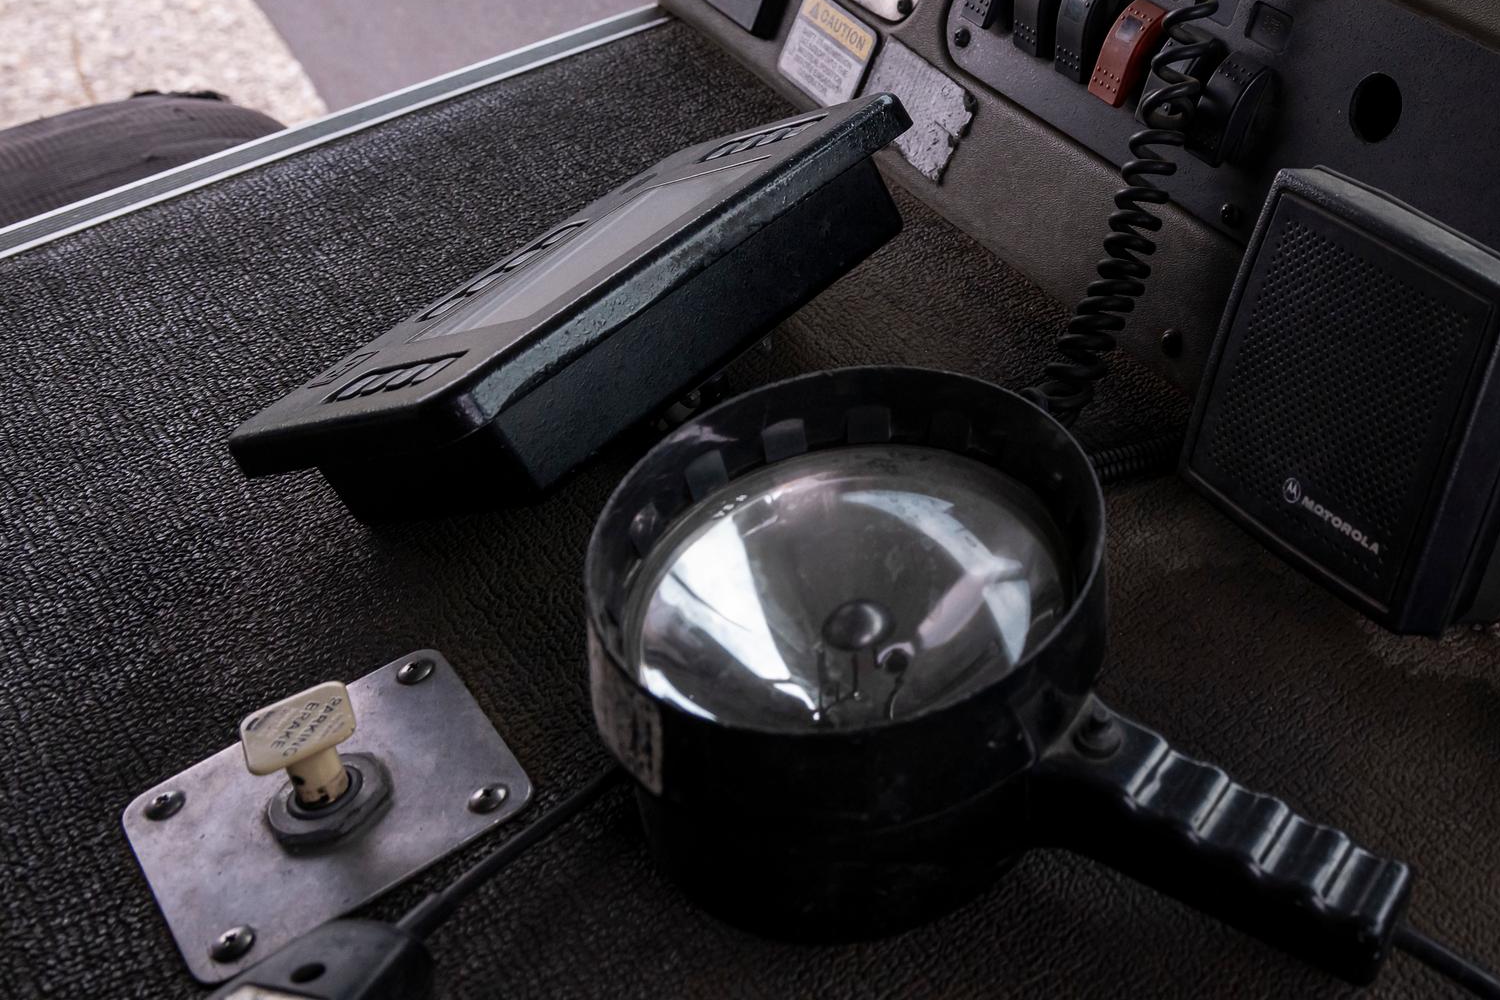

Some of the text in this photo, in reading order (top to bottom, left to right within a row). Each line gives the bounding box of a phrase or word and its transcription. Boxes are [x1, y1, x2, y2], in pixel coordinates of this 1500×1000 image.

[820, 8, 867, 52] CAUTION
[1301, 495, 1380, 555] MOTOROLA
[270, 701, 320, 750] BRAKE
[282, 695, 343, 757] PARKING
